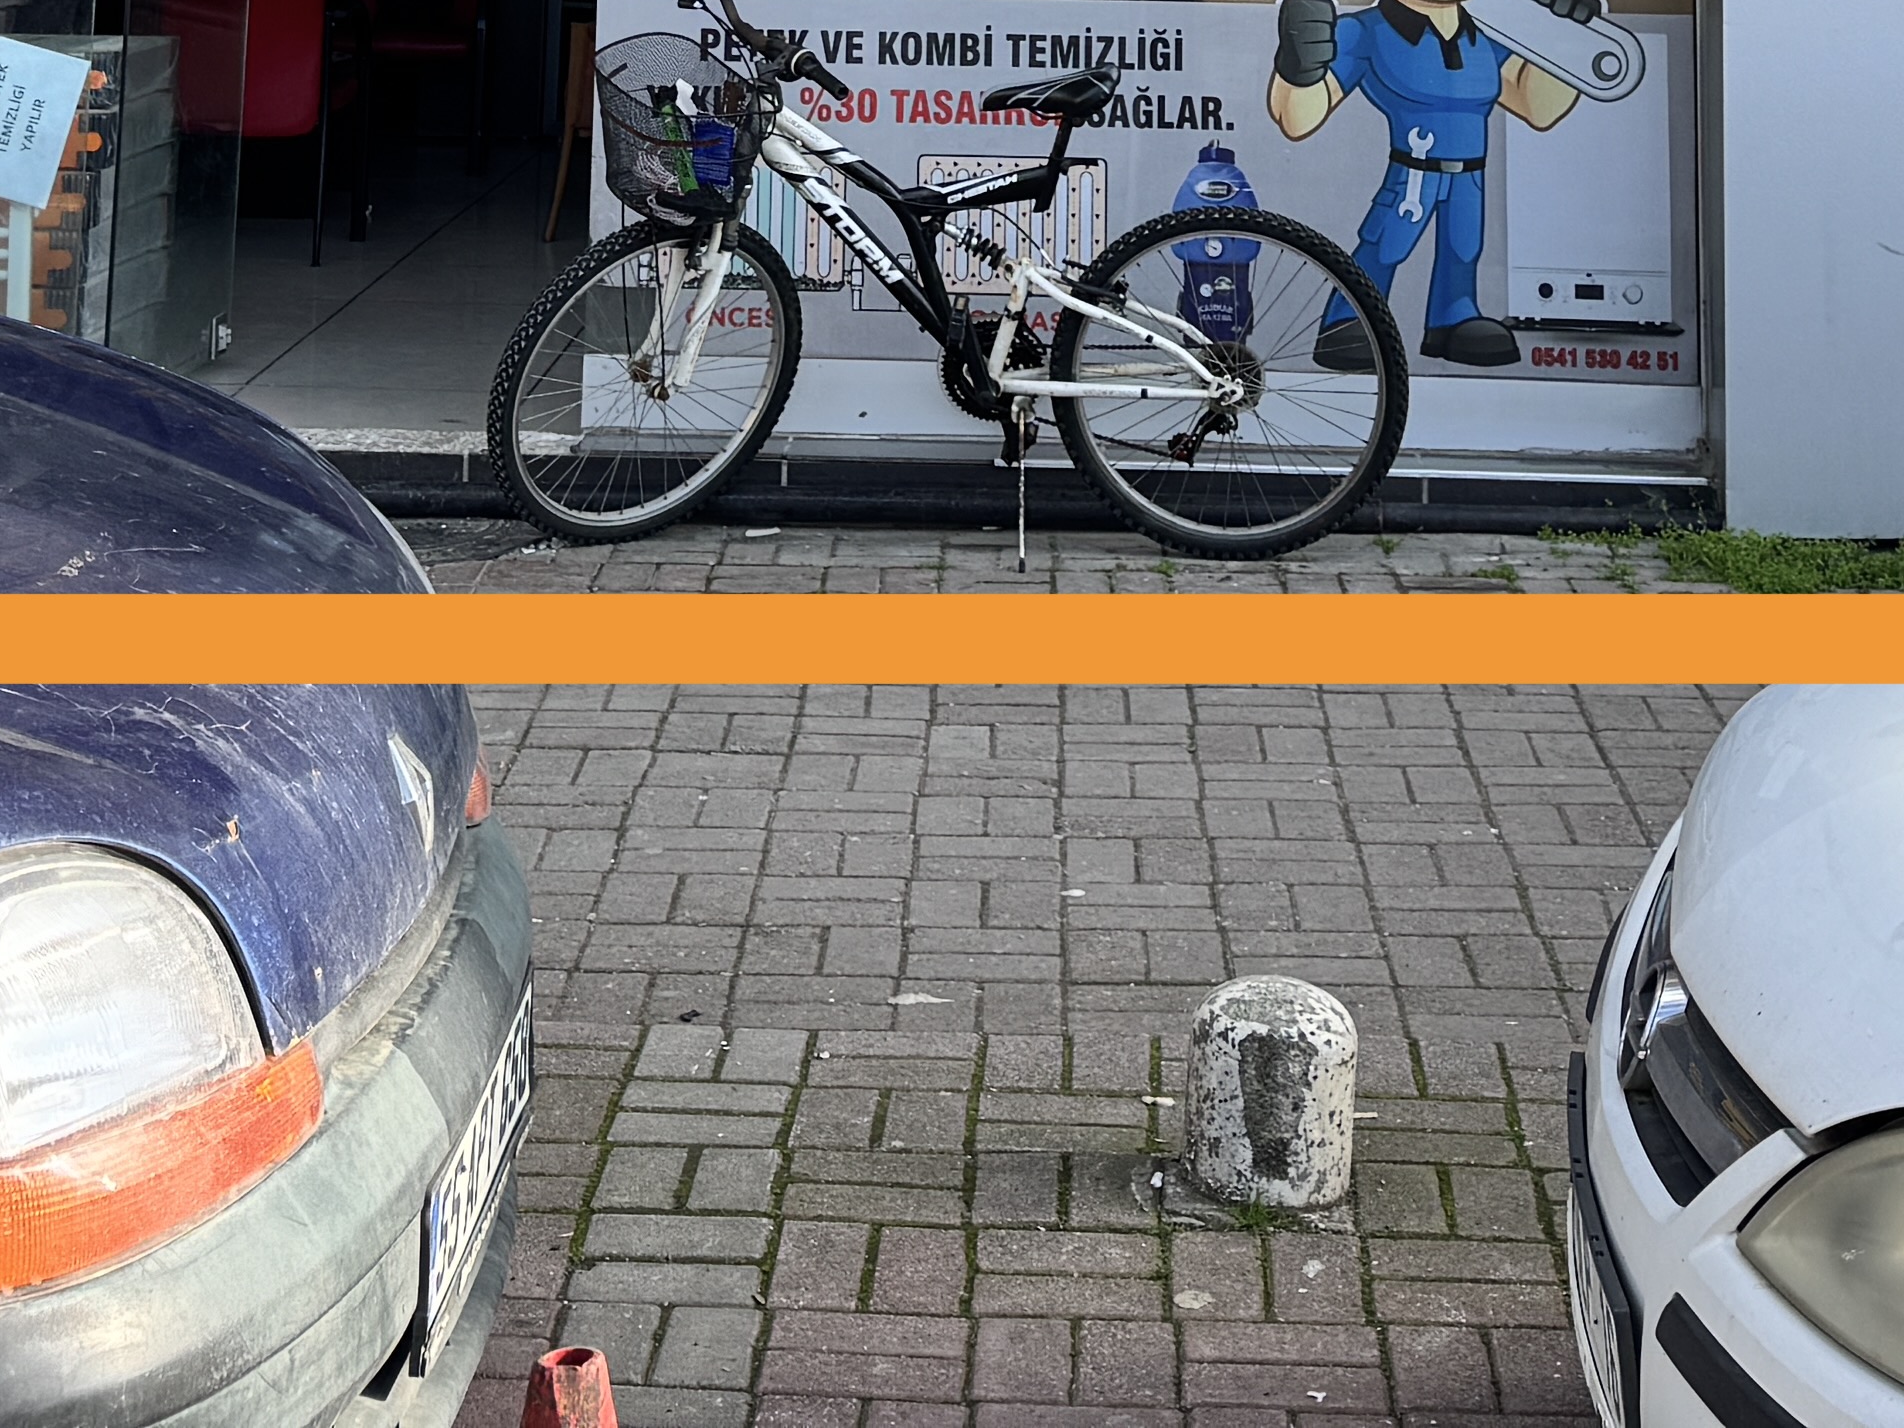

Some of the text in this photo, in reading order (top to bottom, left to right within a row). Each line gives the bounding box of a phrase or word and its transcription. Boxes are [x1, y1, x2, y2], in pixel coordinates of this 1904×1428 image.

[820, 30, 865, 64] VE
[878, 25, 993, 67] KOMBİ
[1006, 26, 1184, 72] TEMİZLİĞİ
[20, 98, 46, 152] YAPILIR
[800, 87, 878, 124] %30
[803, 177, 905, 284] STORM
[1531, 346, 1578, 368] 0541
[1626, 350, 1651, 370] 42
[1657, 351, 1679, 372] 51
